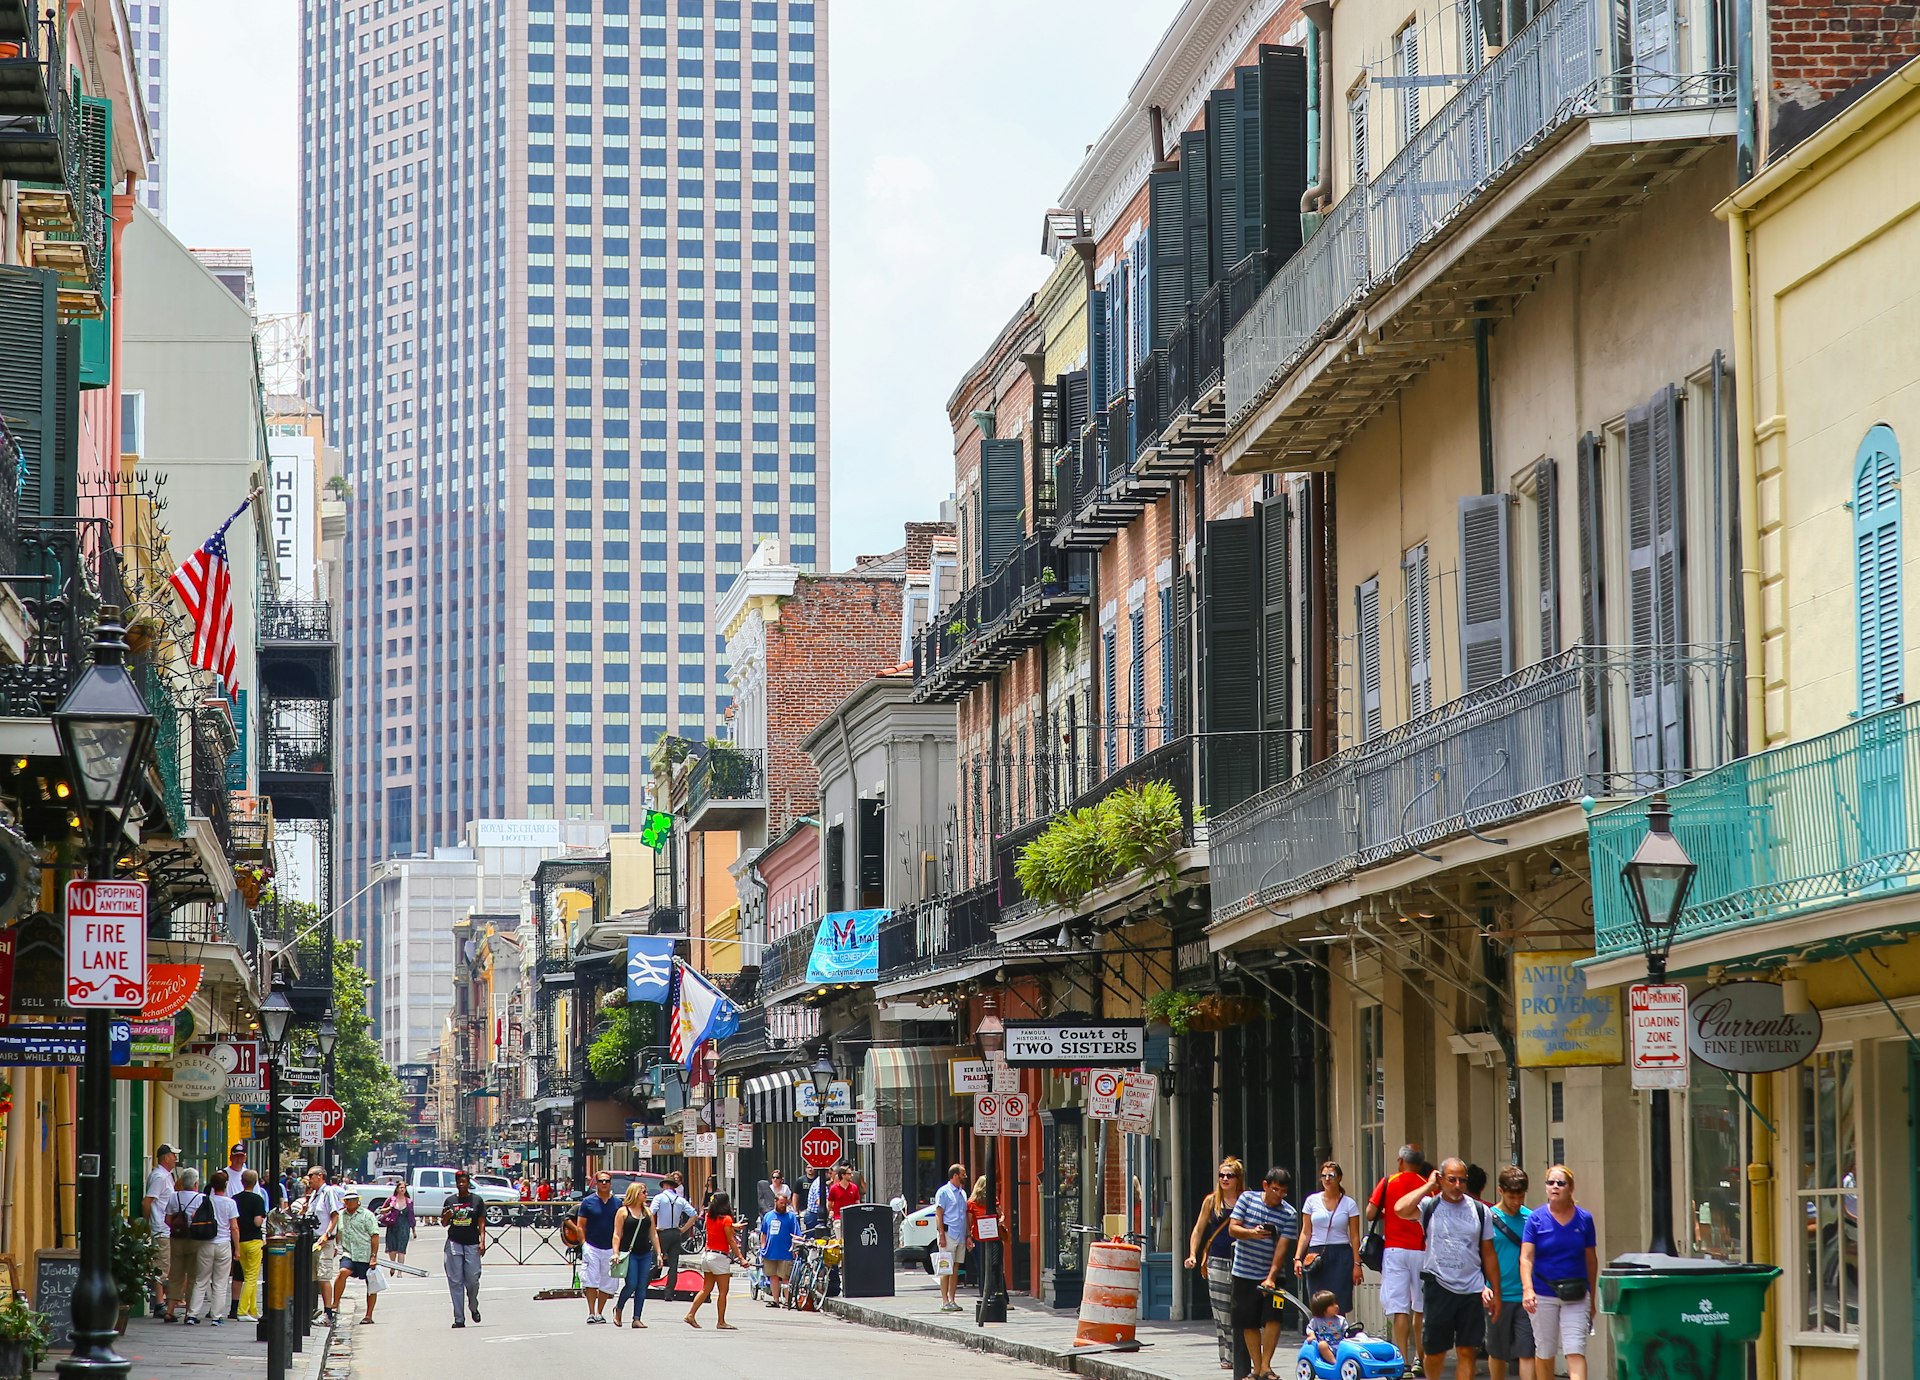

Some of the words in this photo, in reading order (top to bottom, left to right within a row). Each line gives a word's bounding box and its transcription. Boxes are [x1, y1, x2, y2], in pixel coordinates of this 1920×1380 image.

[275, 471, 292, 581] HOTEL
[480, 823, 506, 833] ROYAL
[520, 823, 557, 833] CHARLES
[501, 834, 536, 842] HOTEL
[70, 887, 94, 911] NO
[96, 887, 141, 899] STOPPING
[99, 900, 138, 912] ANYTIME
[86, 924, 126, 943] FIRE
[83, 950, 129, 970] LANE
[1557, 984, 1573, 994] DE
[21, 998, 45, 1007] SELL
[1632, 990, 1649, 1007] NO
[1649, 992, 1681, 1004] PARKING
[1521, 995, 1615, 1015] PROVENCE
[1638, 1016, 1680, 1028] LOADING
[143, 1025, 169, 1034] Artists
[1059, 1029, 1105, 1040] Court
[1111, 1029, 1128, 1041] of
[1521, 1029, 1558, 1039] FRENCH
[1646, 1031, 1673, 1043] ZONE
[130, 1043, 150, 1053] Fairy
[151, 1044, 173, 1052] Store
[1012, 1042, 1053, 1055] TWO
[1060, 1041, 1137, 1054] SISTERS
[1548, 1041, 1589, 1051] JARDINS
[1704, 1040, 1737, 1054] FINE
[1738, 1040, 1802, 1056] JEWELRY
[23, 1053, 52, 1062] WHILE
[57, 1054, 64, 1062] U
[175, 1060, 217, 1076] OREVER
[226, 1076, 257, 1088] OYALE
[284, 1071, 320, 1081] Toulouse
[1092, 1096, 1116, 1104] PASSENGE
[1126, 1090, 1150, 1099] LOADING
[803, 1140, 839, 1156] STOP
[1681, 1310, 1730, 1324] Progressive
